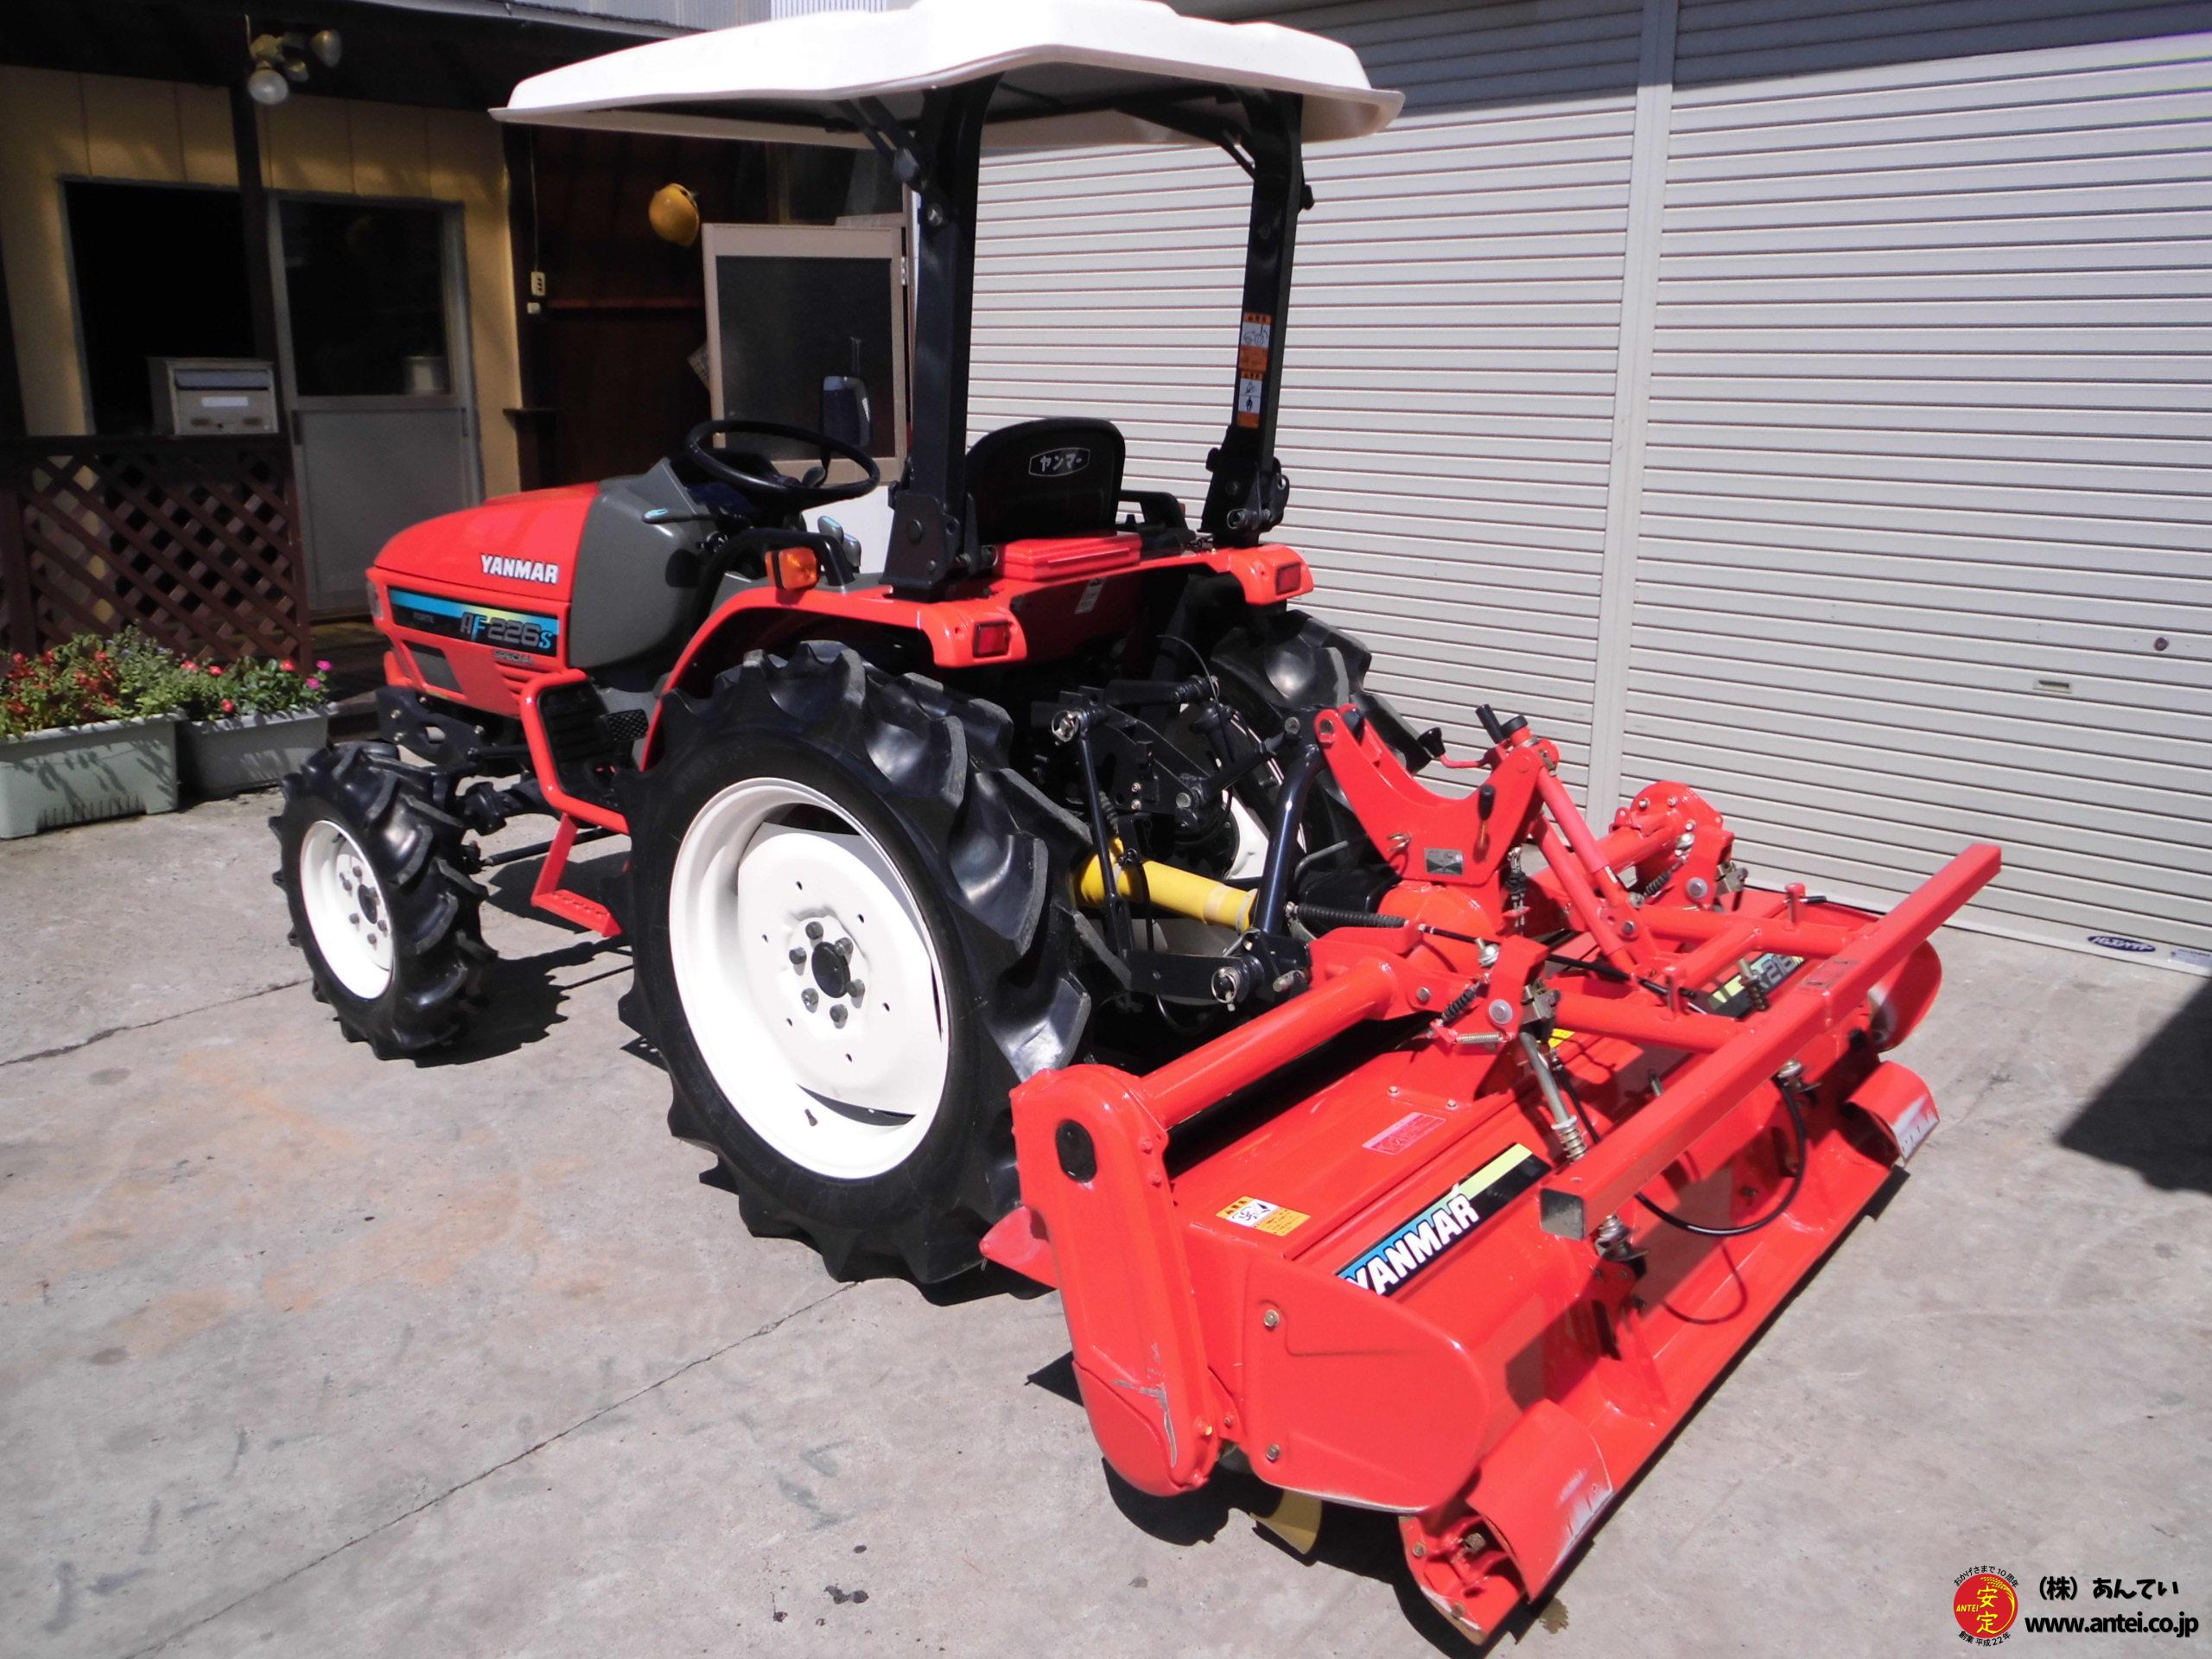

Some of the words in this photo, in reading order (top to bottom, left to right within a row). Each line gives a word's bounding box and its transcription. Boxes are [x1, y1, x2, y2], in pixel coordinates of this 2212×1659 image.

[1039, 453, 1083, 472] ヤンマー
[480, 554, 559, 584] YANMAR
